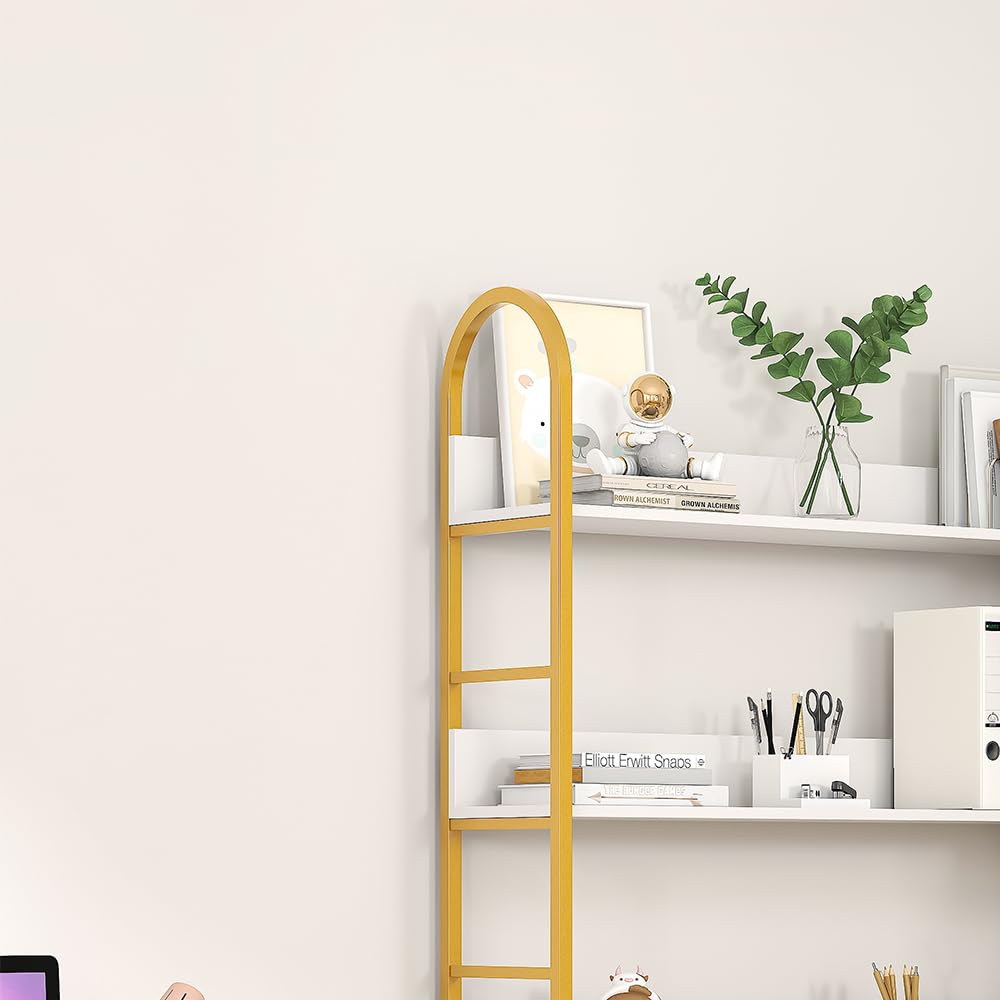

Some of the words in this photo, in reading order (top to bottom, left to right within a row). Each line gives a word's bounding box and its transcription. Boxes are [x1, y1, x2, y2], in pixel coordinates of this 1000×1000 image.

[646, 482, 695, 491] CEREAL
[614, 494, 635, 502] ROWN
[635, 496, 670, 505] ALCHEMIST
[681, 500, 706, 508] GROWN
[706, 502, 740, 510] ALCHEMIS
[585, 752, 615, 767] Elliott
[619, 753, 651, 768] Erwitt
[654, 753, 692, 769] Snaps
